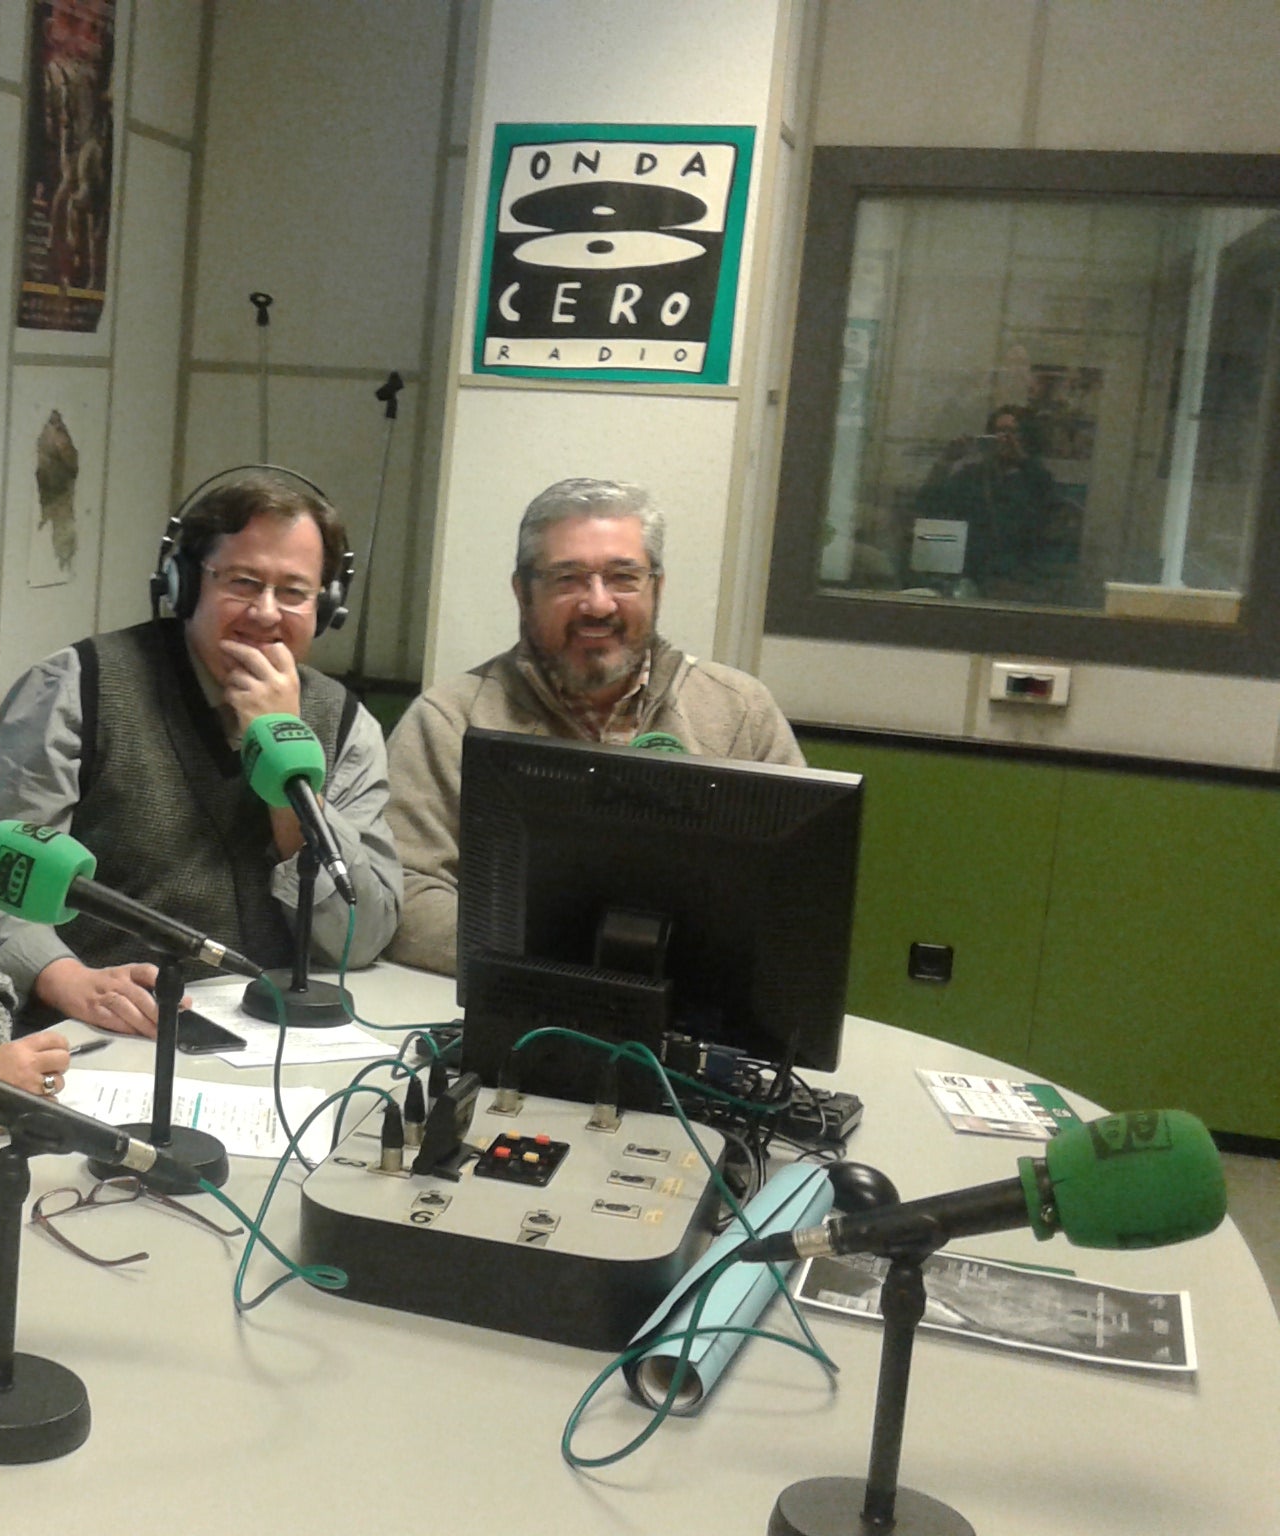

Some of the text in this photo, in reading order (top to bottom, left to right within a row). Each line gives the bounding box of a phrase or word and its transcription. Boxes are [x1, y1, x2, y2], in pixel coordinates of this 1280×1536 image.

[529, 150, 707, 180] ONDA
[498, 281, 691, 326] CERO
[497, 345, 688, 362] RADIO
[410, 1210, 435, 1224] 6
[524, 1229, 548, 1242] 7
